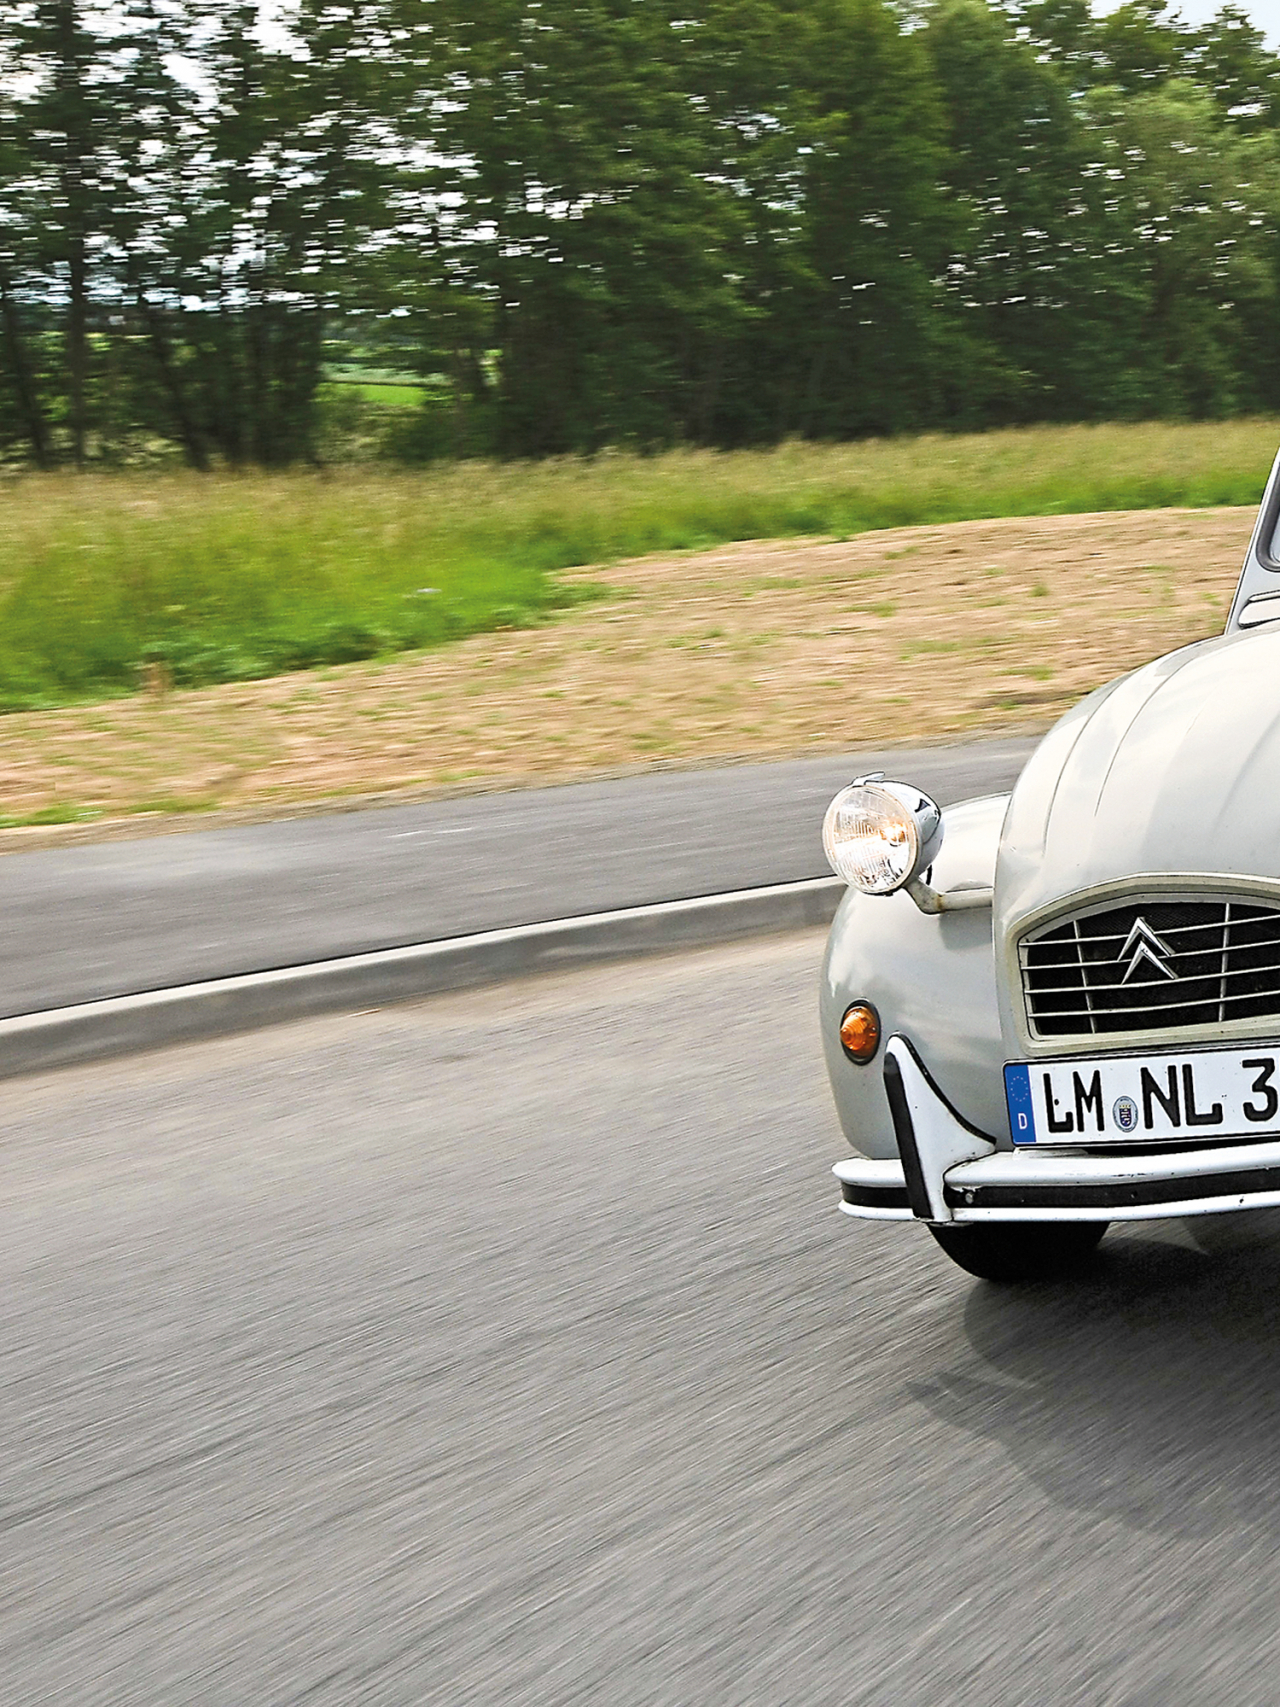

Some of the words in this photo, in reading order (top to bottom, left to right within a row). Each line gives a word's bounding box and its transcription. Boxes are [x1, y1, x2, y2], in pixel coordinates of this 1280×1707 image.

[1043, 1070, 1105, 1133] LM
[1140, 1064, 1223, 1130] NL
[1018, 1112, 1028, 1130] D
